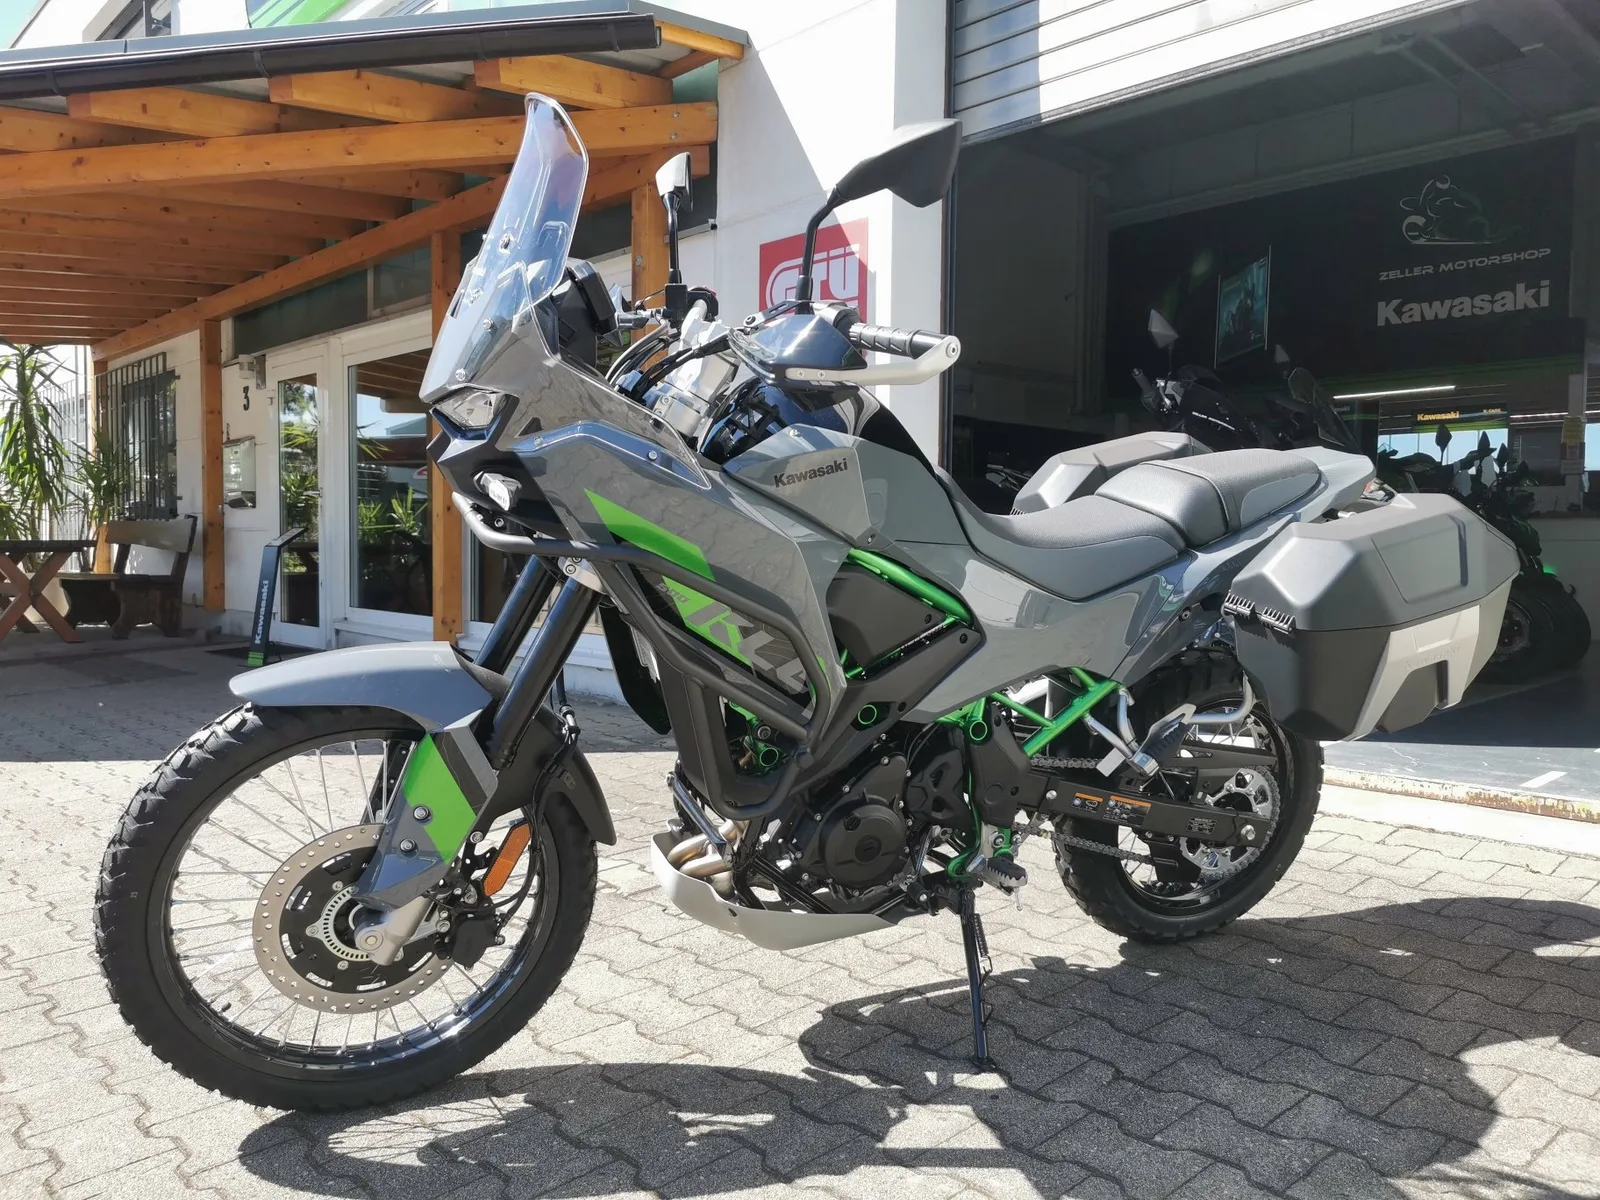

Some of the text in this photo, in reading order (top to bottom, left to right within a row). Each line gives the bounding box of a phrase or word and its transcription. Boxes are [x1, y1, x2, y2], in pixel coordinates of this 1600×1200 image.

[1379, 248, 1552, 281] ZELLER MOTORSHOP
[1377, 279, 1550, 327] Kawasaki
[242, 386, 250, 411] 3
[1417, 411, 1460, 421] Kawasaki
[774, 458, 848, 488] Kawasaki
[254, 580, 269, 644] Kawasaki
